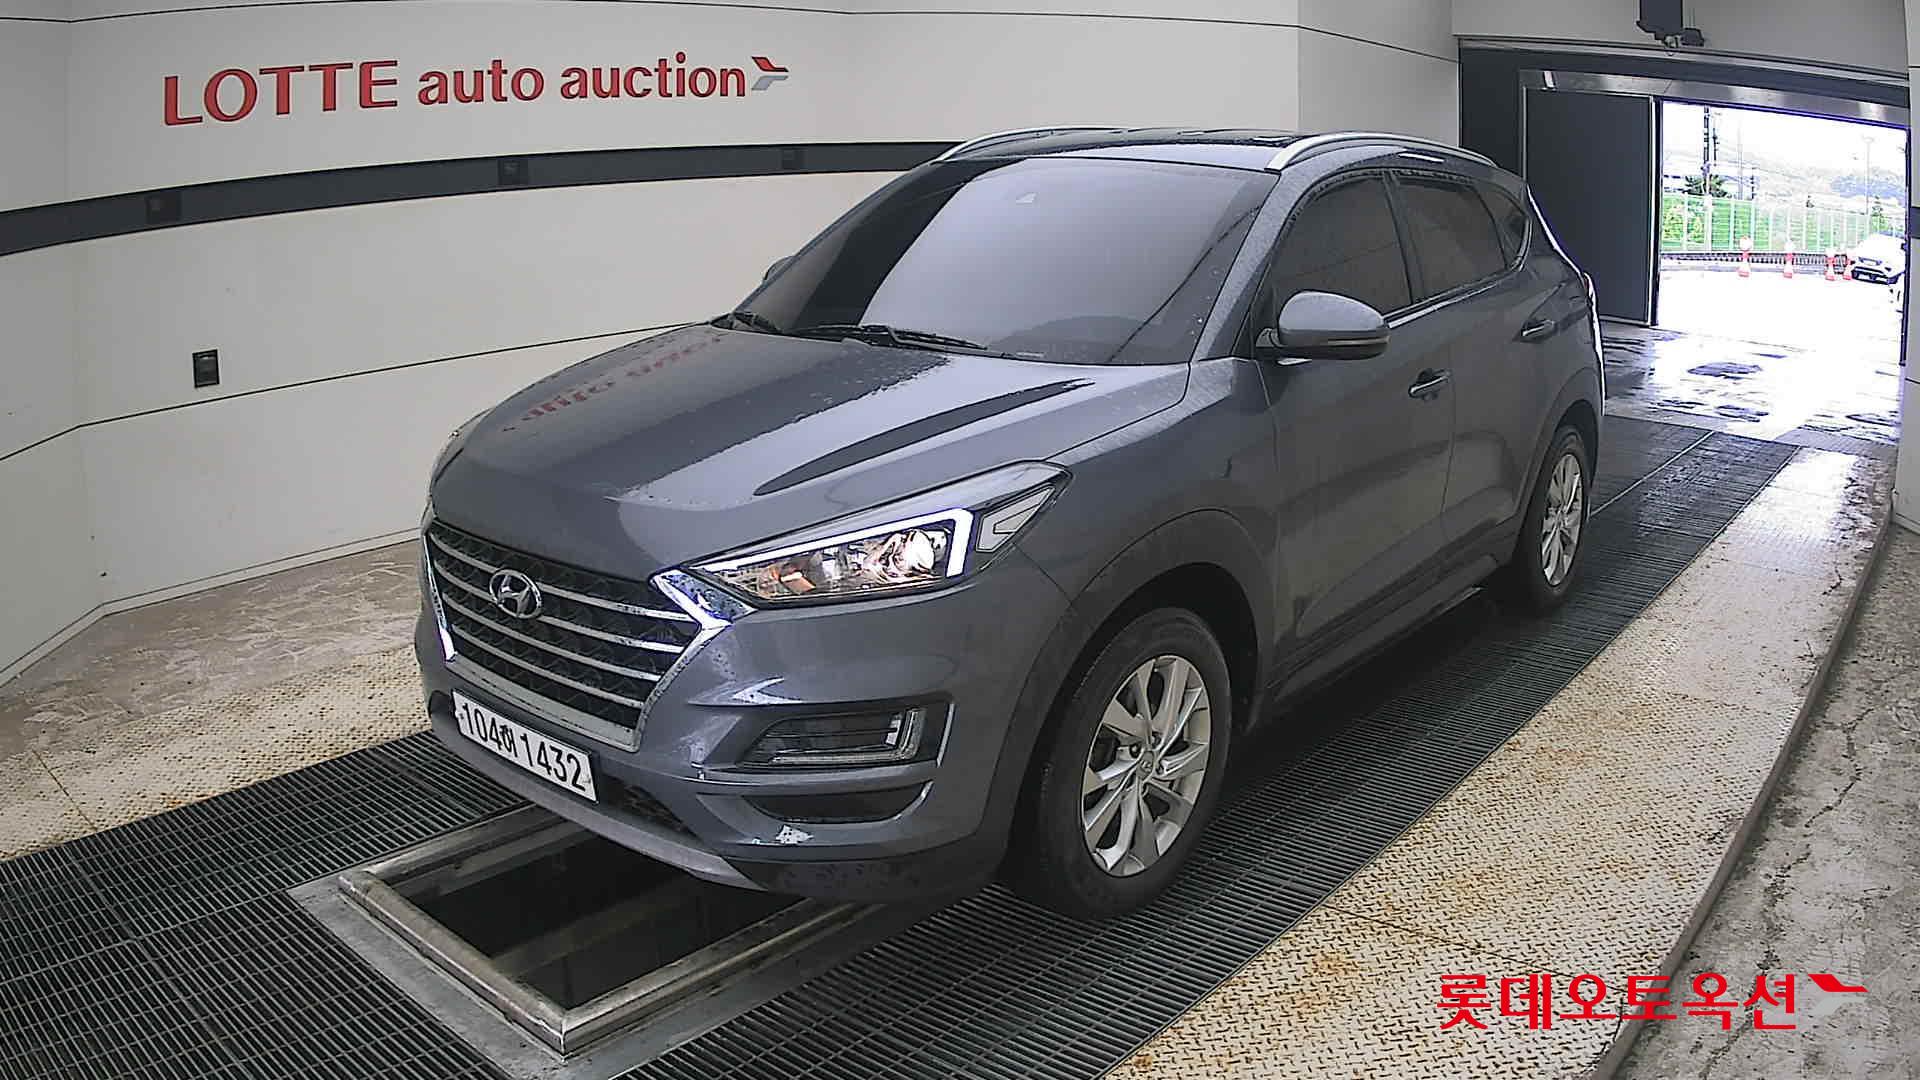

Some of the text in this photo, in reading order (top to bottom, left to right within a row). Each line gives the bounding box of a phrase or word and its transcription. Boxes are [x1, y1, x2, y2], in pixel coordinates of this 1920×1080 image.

[164, 51, 747, 126] LOTTE auto auction
